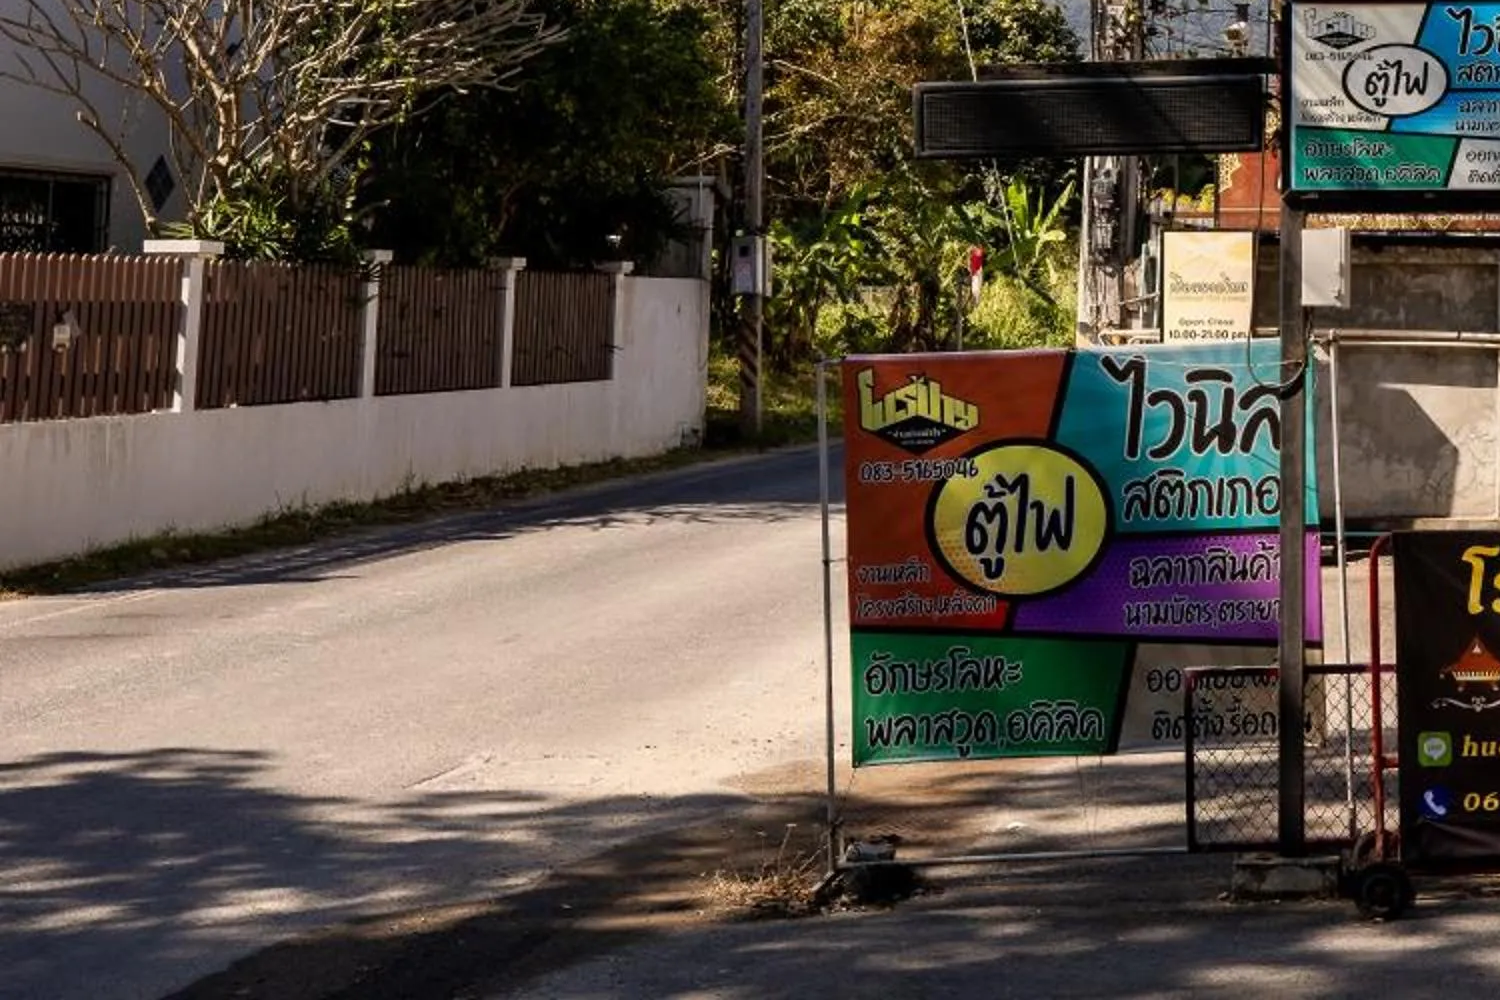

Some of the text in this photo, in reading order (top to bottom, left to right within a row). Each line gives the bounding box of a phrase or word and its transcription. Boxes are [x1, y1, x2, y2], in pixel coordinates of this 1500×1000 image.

[1364, 58, 1429, 107] ตู้ไฟ
[965, 473, 1075, 579] ตู้ไฟ
[865, 648, 1023, 695] อักษรโลหะ
